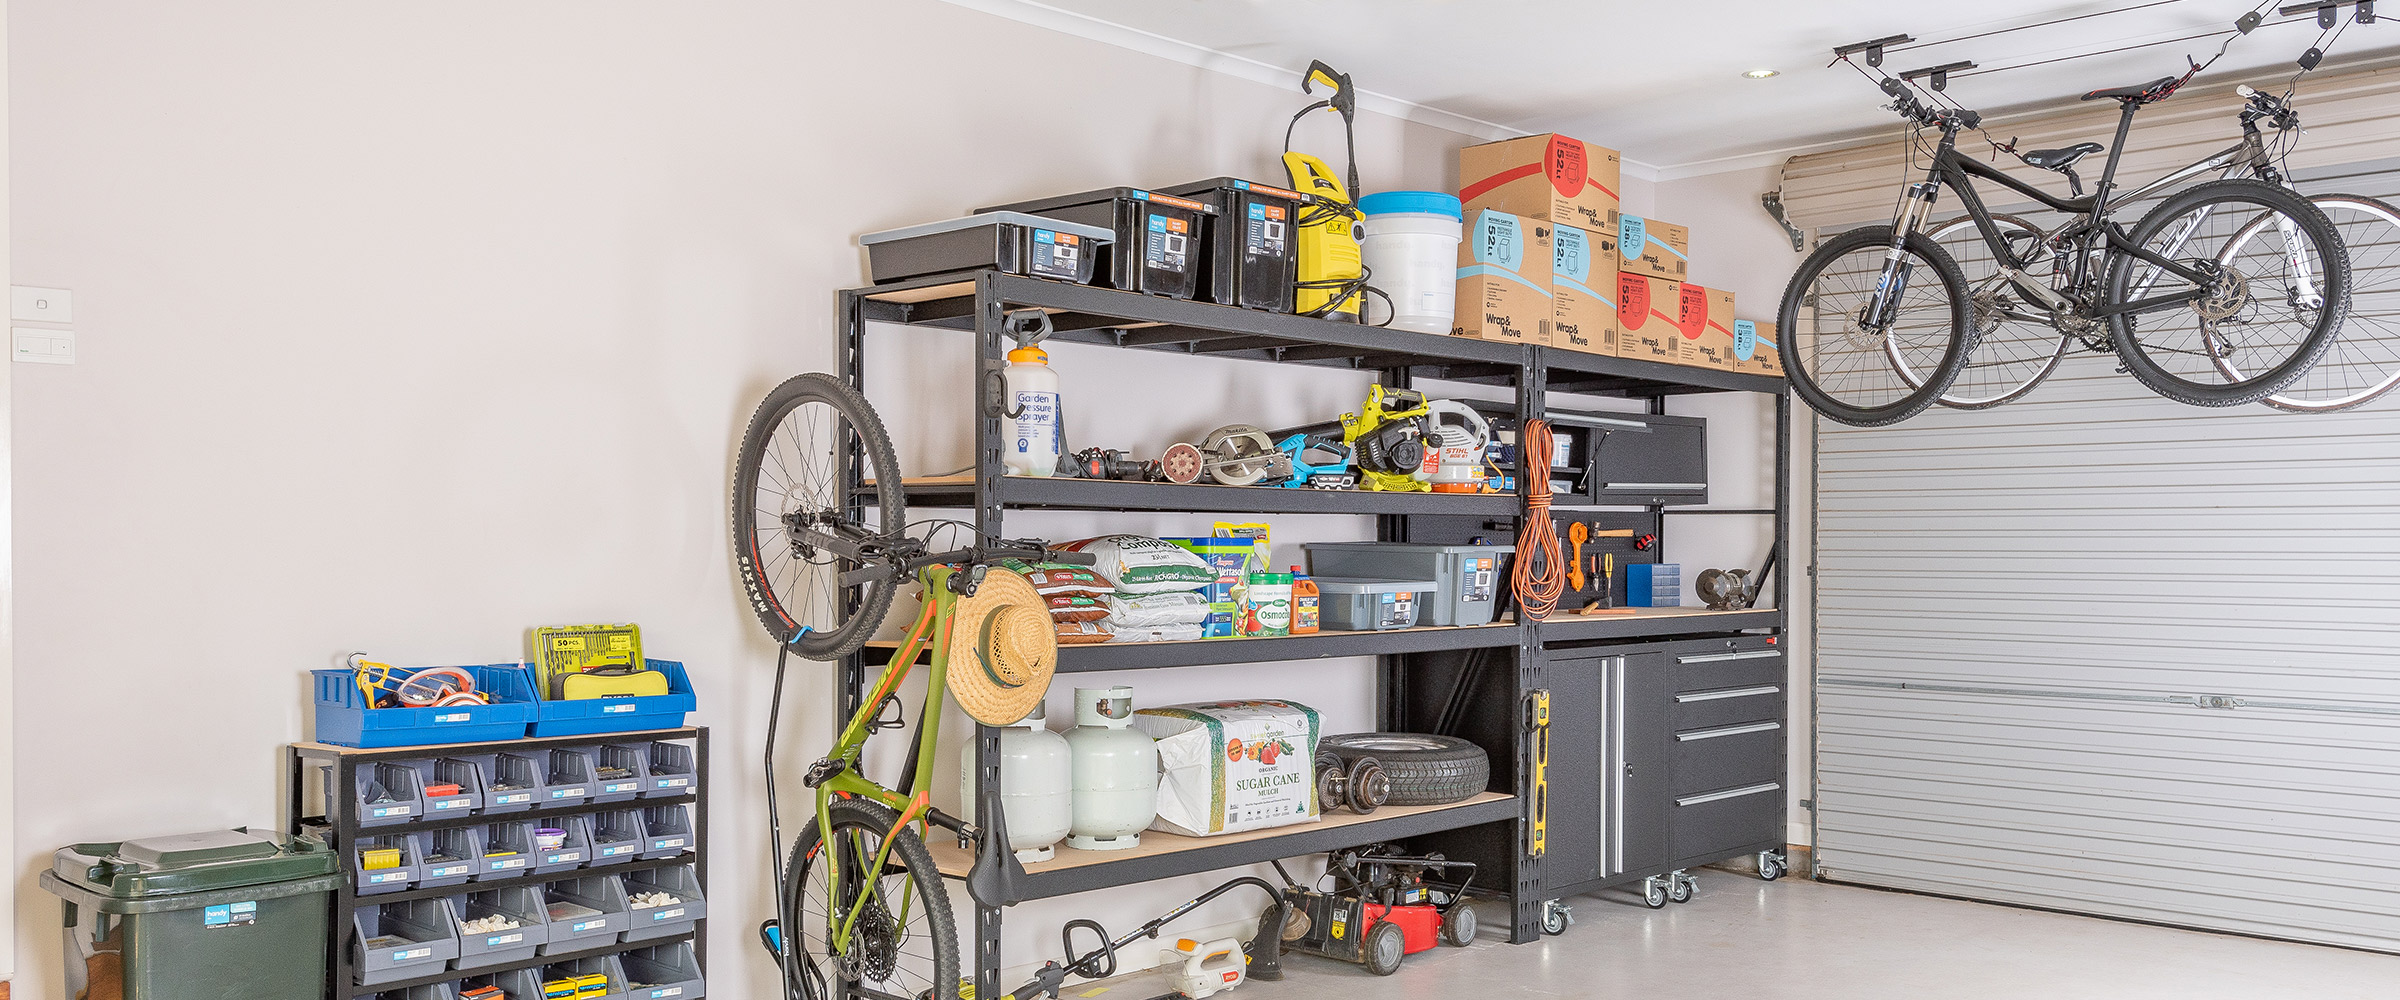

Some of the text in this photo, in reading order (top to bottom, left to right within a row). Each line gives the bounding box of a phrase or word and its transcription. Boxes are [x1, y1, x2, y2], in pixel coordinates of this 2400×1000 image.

[1578, 205, 1597, 218] Wrap&
[1152, 219, 1164, 228] handy
[1589, 217, 1605, 228] Move
[1642, 254, 1658, 264] Wrap&
[1652, 264, 1665, 272] Move
[1486, 313, 1511, 328] Wrap&
[1501, 326, 1521, 338] Move
[1556, 322, 1578, 335] Wrap&
[1570, 334, 1588, 346] Move
[1642, 337, 1659, 346] Wrap&
[1652, 347, 1666, 356] Move
[1700, 346, 1715, 356] Wrap&
[1709, 356, 1722, 364] Move
[742, 556, 768, 612] MAXXIS
[840, 659, 894, 748] MERIDA
[1236, 773, 1300, 791] SUGAR CANE
[1258, 788, 1278, 796] MULCH
